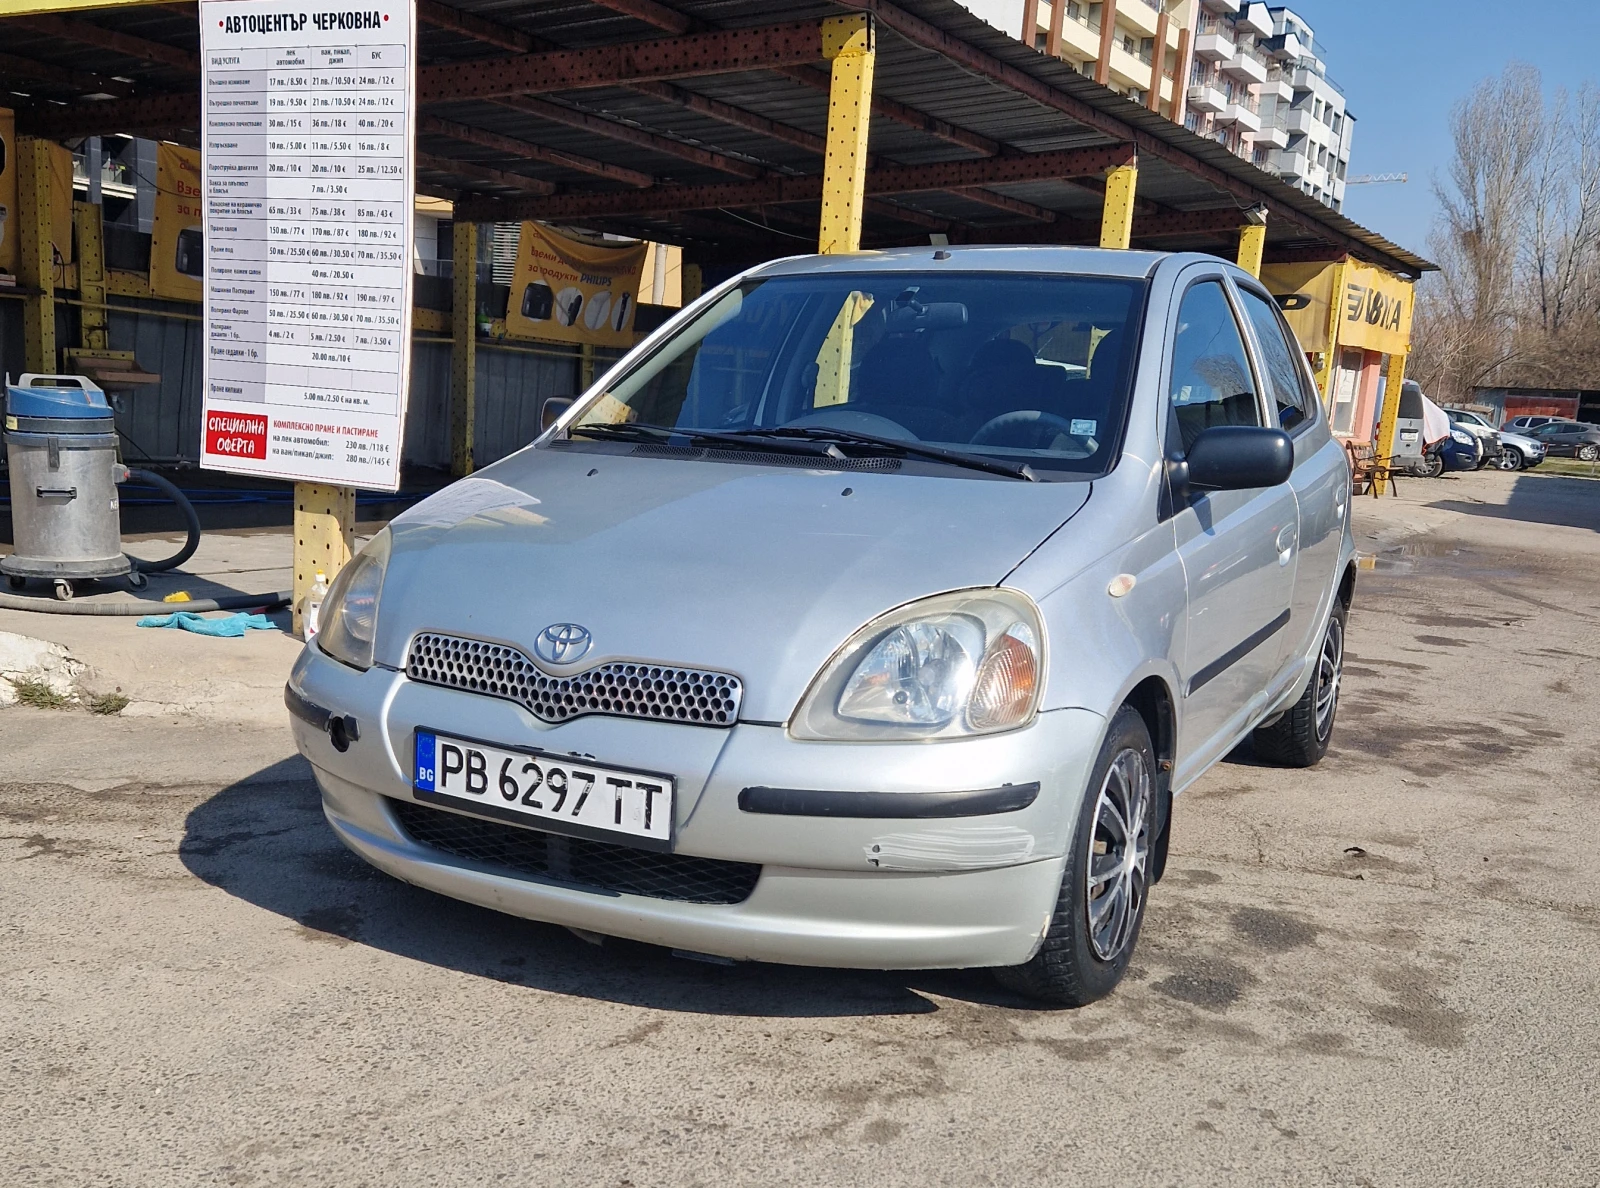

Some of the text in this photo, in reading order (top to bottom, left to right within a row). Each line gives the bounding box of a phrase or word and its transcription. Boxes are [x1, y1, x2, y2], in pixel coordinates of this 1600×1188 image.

[225, 11, 381, 34] АВТОЦЕНТЪР ЧЕРКОВНА
[212, 57, 222, 66] ВИД
[276, 58, 305, 66] автомобил
[335, 77, 351, 85] 10.50
[382, 76, 390, 84] 12
[290, 98, 302, 106] 9.50
[313, 98, 351, 106] 21 10.50
[269, 119, 297, 127] 30 15
[312, 119, 341, 127] 36 18
[358, 119, 389, 127] 40 20
[269, 142, 302, 150] 10 5.00
[312, 142, 347, 150] 11 5.50
[269, 164, 297, 172] 20 10
[312, 164, 319, 172] 20
[358, 165, 398, 174] 25 12.50
[177, 180, 200, 196] Взе
[330, 185, 343, 193] 3.50
[177, 205, 190, 215] за
[269, 206, 276, 214] 65
[334, 208, 341, 216] 38
[270, 227, 300, 235] 150 77
[312, 228, 322, 236] 170
[357, 230, 391, 238] 180 92
[269, 247, 305, 256] 50 25.50
[312, 249, 350, 258] 60 30.50
[380, 252, 397, 260] 35.50
[333, 271, 349, 279] 20.50
[528, 264, 538, 272] за
[580, 273, 612, 286] PHILIPS
[270, 289, 300, 298] 150 77
[312, 291, 321, 299] 180
[383, 295, 390, 303] 97
[290, 310, 305, 318] 25.50
[312, 312, 348, 321] 60 30.50
[378, 316, 395, 324] 35.50
[329, 334, 341, 342] 2.50
[374, 337, 387, 345] 3.50
[211, 346, 225, 356] Пране
[312, 353, 327, 361] 20.00
[304, 392, 316, 400] 5.00
[209, 417, 265, 435] СПЕЦИАЛНА
[273, 420, 378, 438] КОМПЛЕКСНО ПРАНЕ И ПАСТИРАНЕ
[217, 436, 255, 454] ОФЕРТА
[293, 436, 329, 447] автомобил:
[346, 441, 357, 449] 230
[346, 454, 357, 463] 280
[386, 458, 390, 466] €
[419, 767, 434, 782] BG
[441, 743, 663, 831] PB 6297 TT
